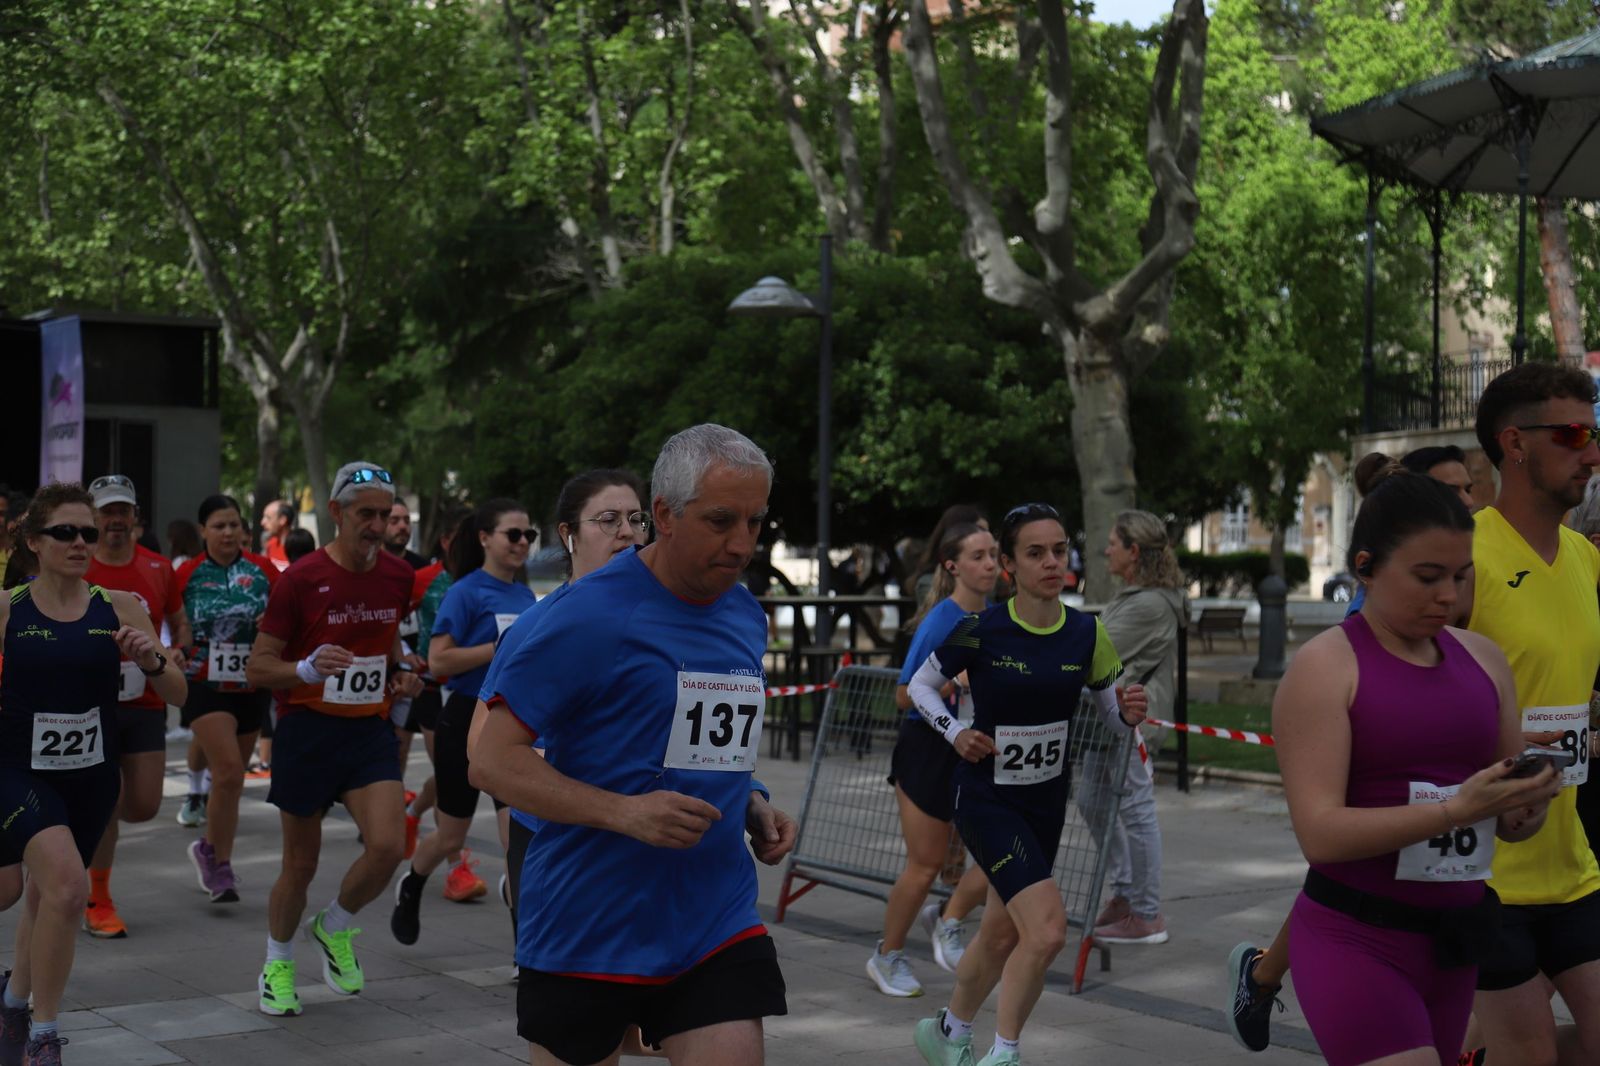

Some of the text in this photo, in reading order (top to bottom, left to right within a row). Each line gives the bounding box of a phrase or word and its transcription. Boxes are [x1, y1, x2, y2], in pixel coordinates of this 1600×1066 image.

[328, 613, 348, 625] MUY
[730, 668, 758, 676] CASTILLA
[334, 670, 381, 693] 103
[682, 680, 696, 688] DÍA
[708, 682, 739, 692] CASTILLA
[739, 684, 744, 692] Y
[745, 683, 761, 692] LEÓN
[1528, 712, 1541, 721] DÍA
[1555, 712, 1580, 720] CASTILLA
[686, 701, 758, 747] 137
[1021, 729, 1048, 737] CASTILLA
[40, 725, 98, 756] 227
[1544, 728, 1587, 767] 88
[1003, 739, 1061, 770] 245
[1415, 791, 1429, 799] DÍA
